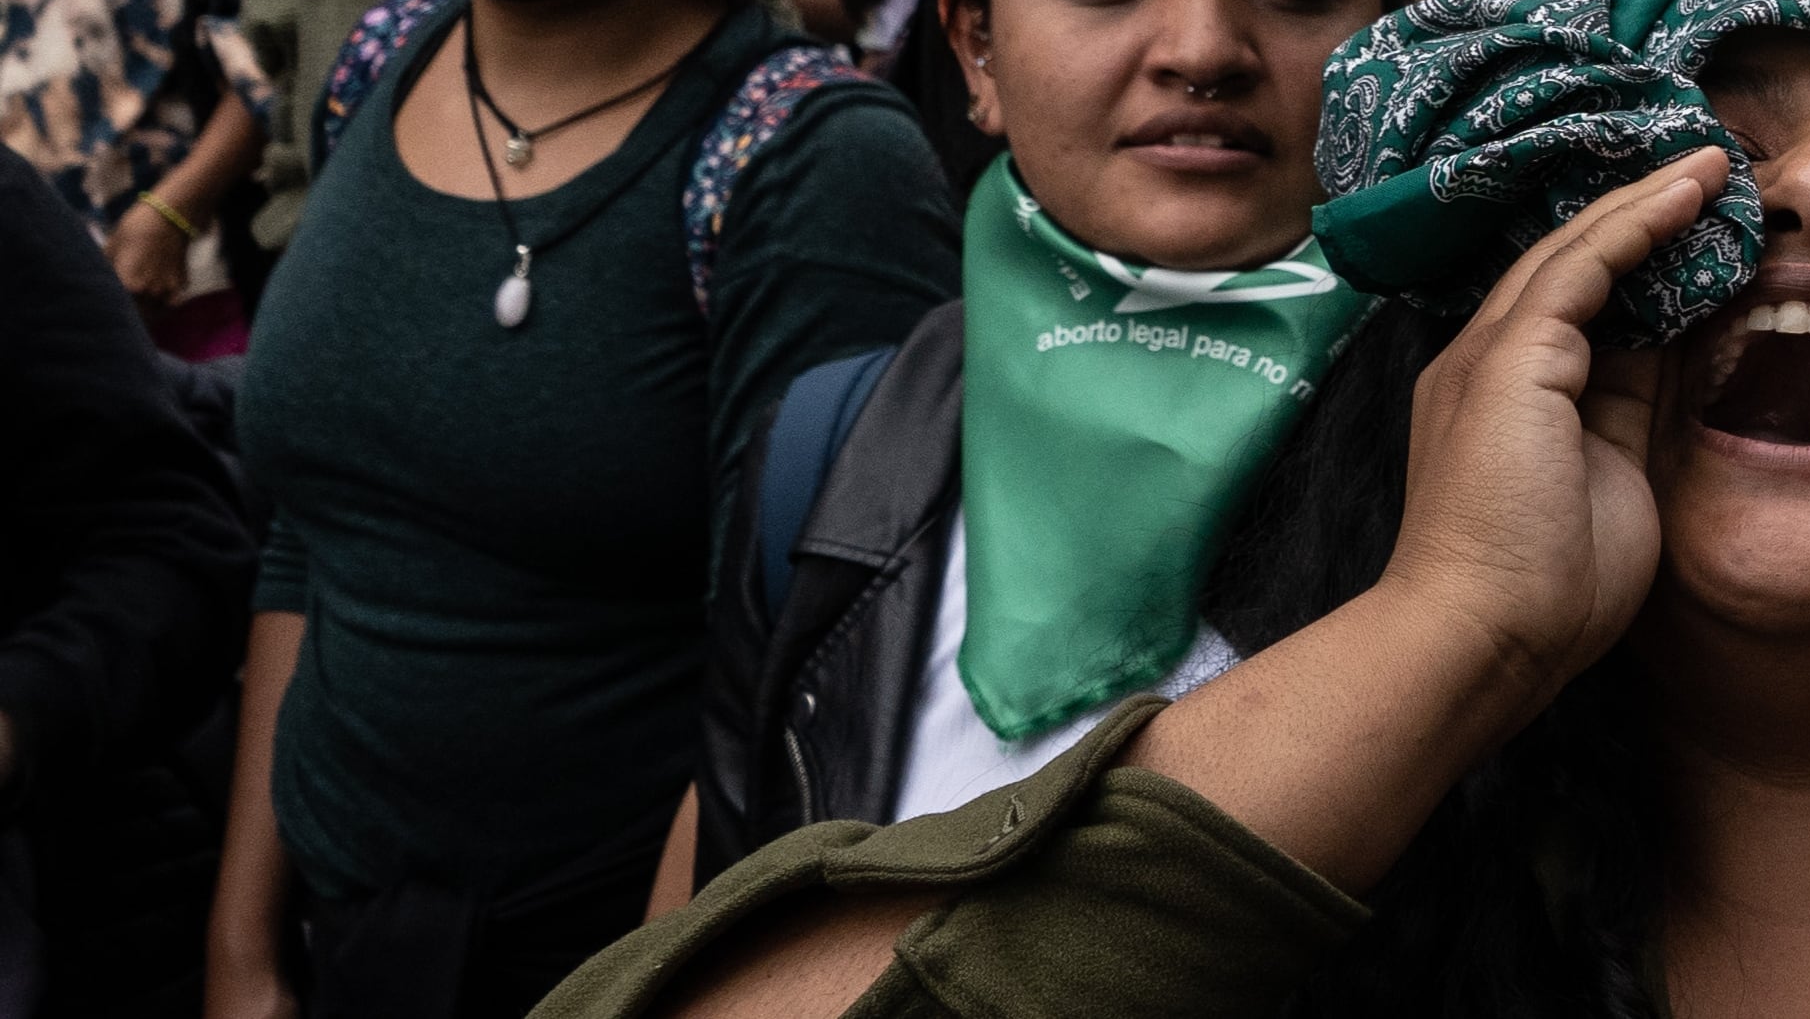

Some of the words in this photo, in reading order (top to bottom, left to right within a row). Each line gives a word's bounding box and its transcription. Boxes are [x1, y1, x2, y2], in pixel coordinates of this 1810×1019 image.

[1036, 319, 1122, 353] aborto
[1127, 318, 1190, 353] legal
[1190, 334, 1253, 369] para
[1252, 356, 1289, 385] no
